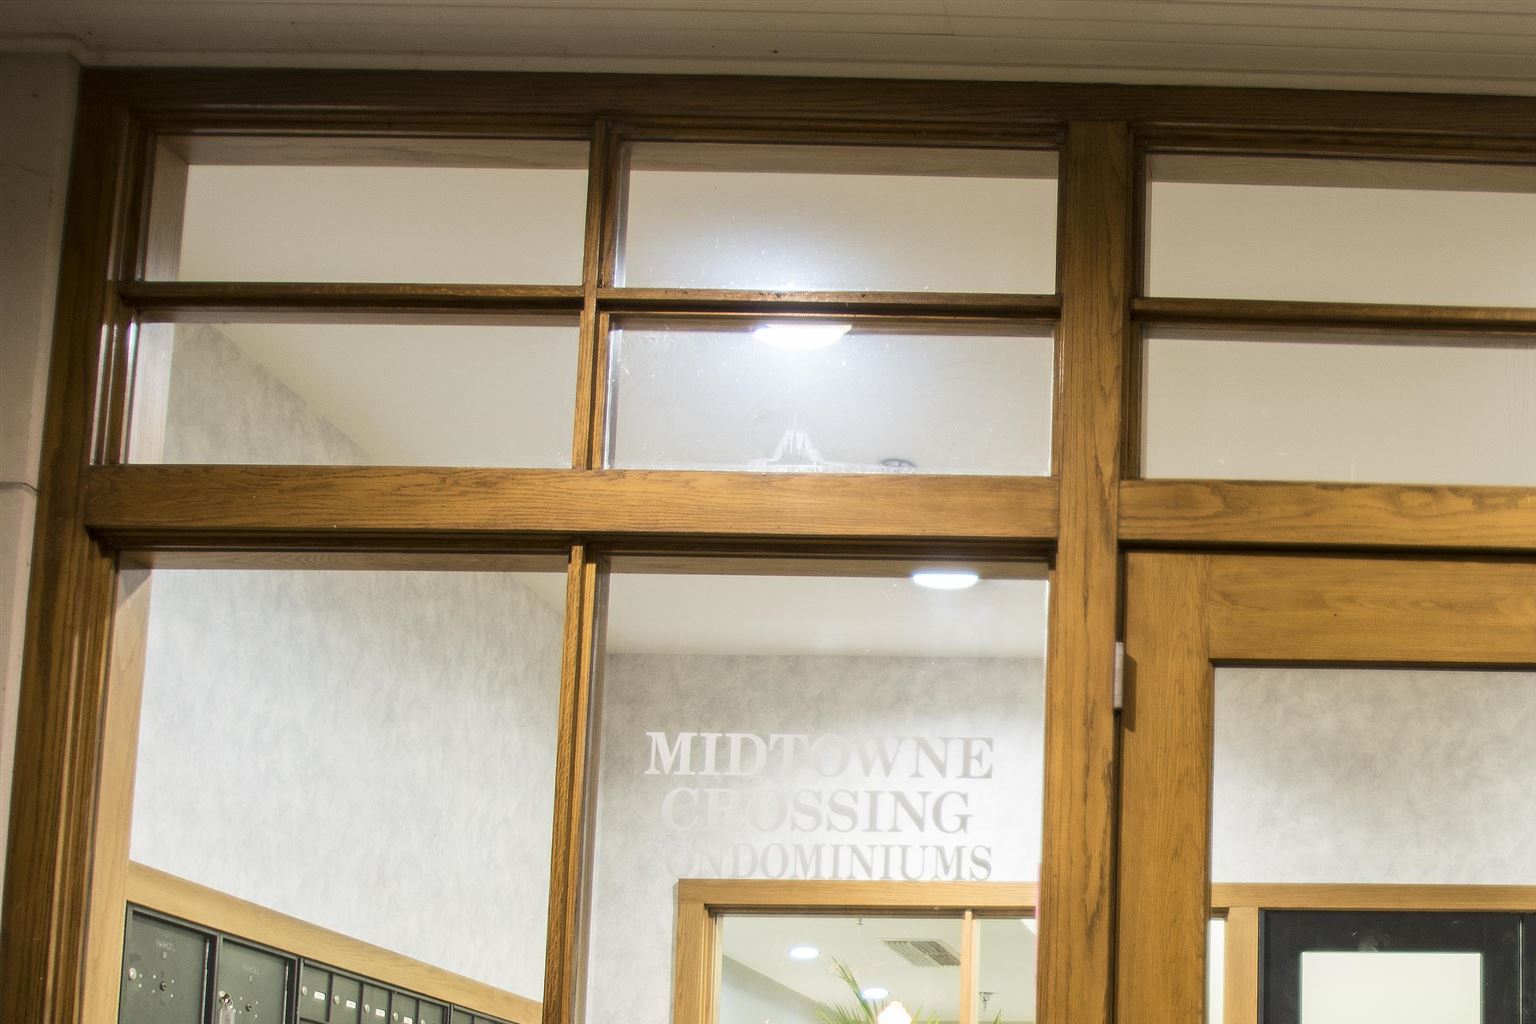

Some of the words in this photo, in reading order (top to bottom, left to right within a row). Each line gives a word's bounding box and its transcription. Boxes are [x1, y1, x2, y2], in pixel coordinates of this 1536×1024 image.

[643, 730, 995, 780] MIDTOWNE
[661, 787, 973, 835] CROSSING
[638, 842, 993, 882] ONDOMINIUMS
